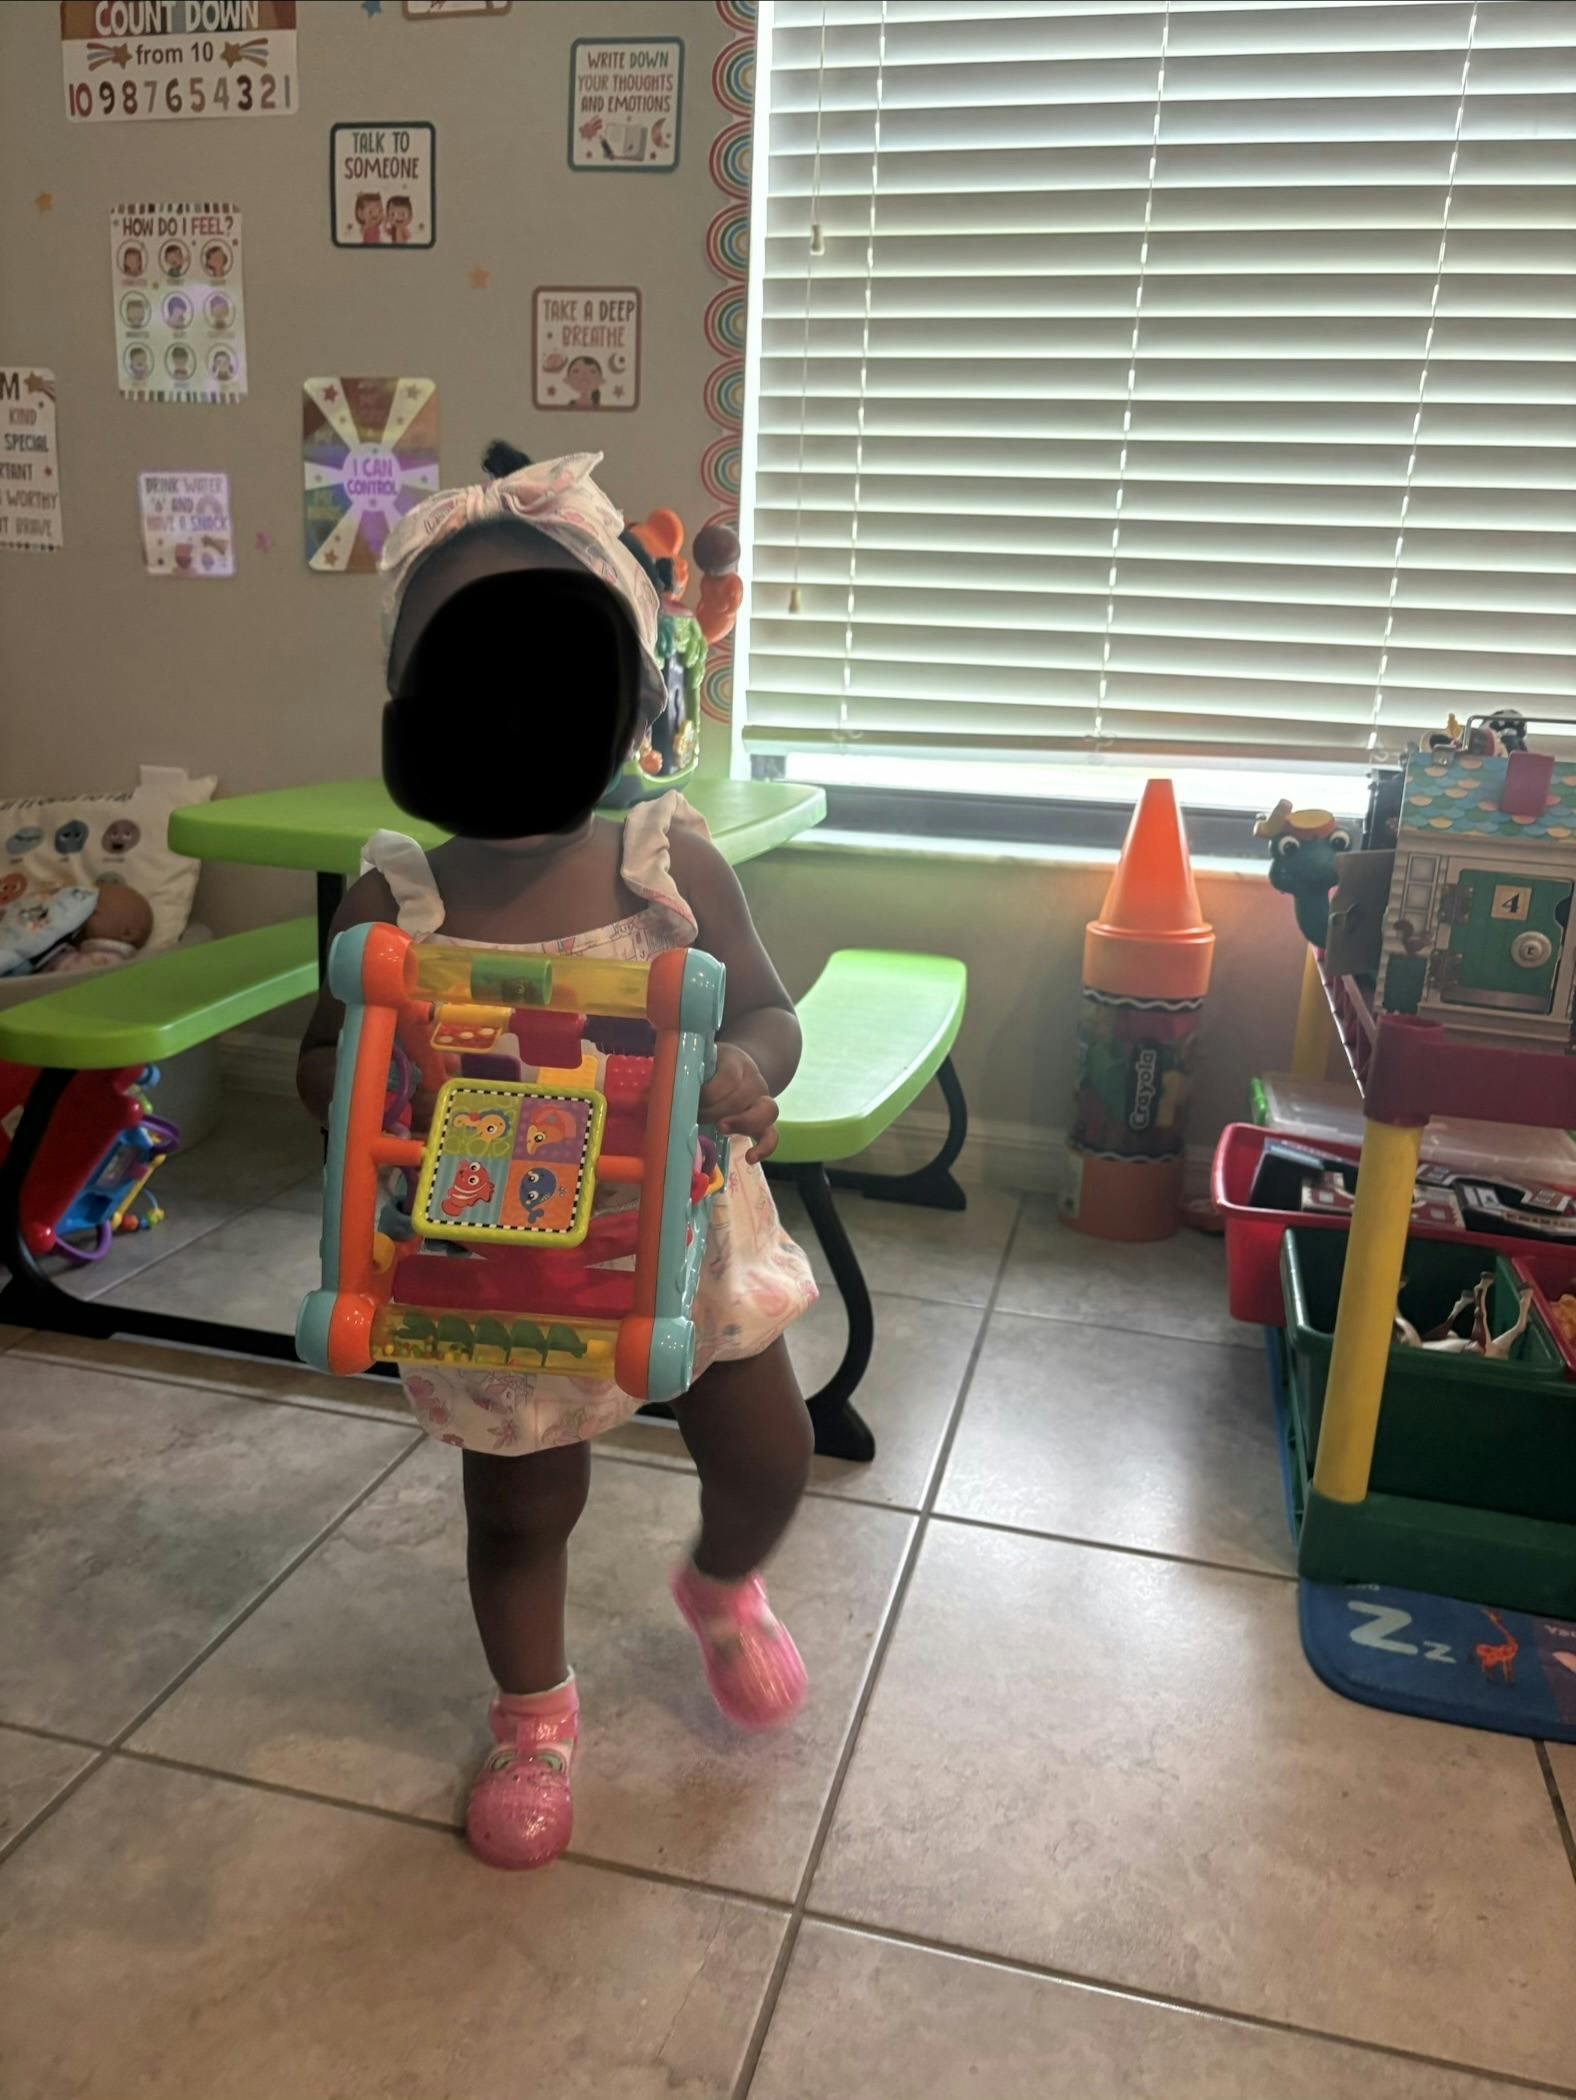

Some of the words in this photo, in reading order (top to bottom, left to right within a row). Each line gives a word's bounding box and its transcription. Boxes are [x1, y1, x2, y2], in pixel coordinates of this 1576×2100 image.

[95, 1, 176, 35] COUNT
[185, 1, 259, 33] DOWN
[136, 44, 183, 65] from
[191, 41, 213, 63] 10
[588, 51, 625, 69] WRITE
[629, 51, 669, 69] DOWN
[578, 74, 609, 92] YOUR
[613, 73, 674, 92] THOUGHTS
[69, 82, 93, 118] 10
[100, 81, 115, 115] 9
[122, 80, 138, 115] 8
[144, 81, 158, 113] 7
[165, 78, 182, 113] 6
[190, 77, 206, 113] 5
[213, 77, 229, 111] 4
[237, 74, 253, 111] 3
[260, 74, 276, 109] 2
[581, 95, 605, 113] AND
[608, 94, 672, 113] EMOTIONS
[352, 131, 385, 154] TALK
[392, 131, 410, 154] TO
[344, 156, 419, 179] SOMEONE
[123, 217, 154, 237] HOW
[158, 216, 178, 237] DO
[182, 216, 187, 237] I
[191, 215, 234, 237] FEEL?
[544, 299, 578, 322] TAKE
[584, 299, 593, 322] A
[600, 299, 635, 322] DEEP
[562, 325, 626, 348] BREATHE
[4, 432, 49, 453] SPECIAL
[352, 458, 358, 477] I
[363, 457, 393, 478] CAN
[6, 488, 57, 510] WORTHY
[347, 479, 399, 497] CONTROL
[1502, 892, 1520, 913] 4
[1130, 1050, 1157, 1130] Crayola
